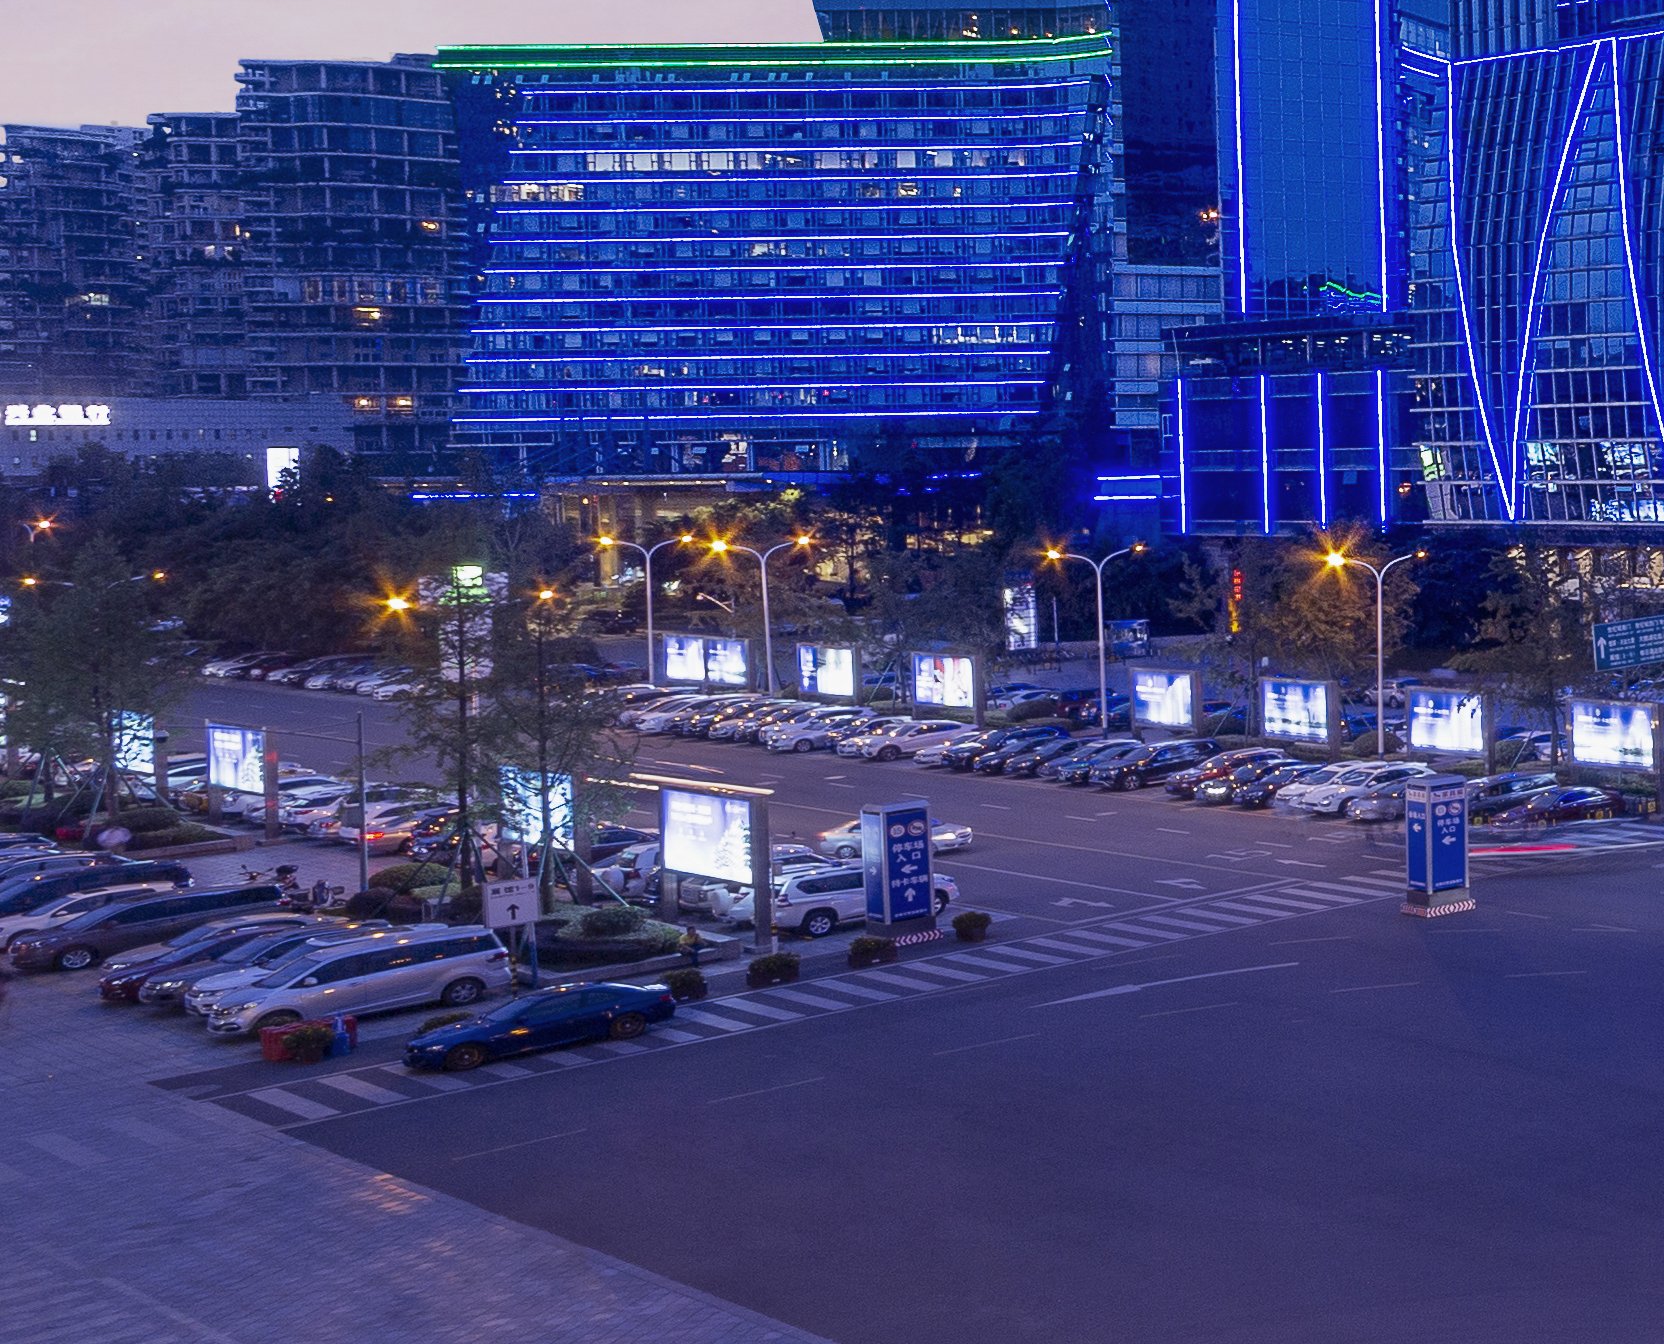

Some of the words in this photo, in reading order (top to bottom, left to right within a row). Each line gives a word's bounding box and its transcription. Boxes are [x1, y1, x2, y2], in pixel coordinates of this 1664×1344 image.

[892, 840, 925, 854] 停车场
[896, 851, 922, 863] 入口
